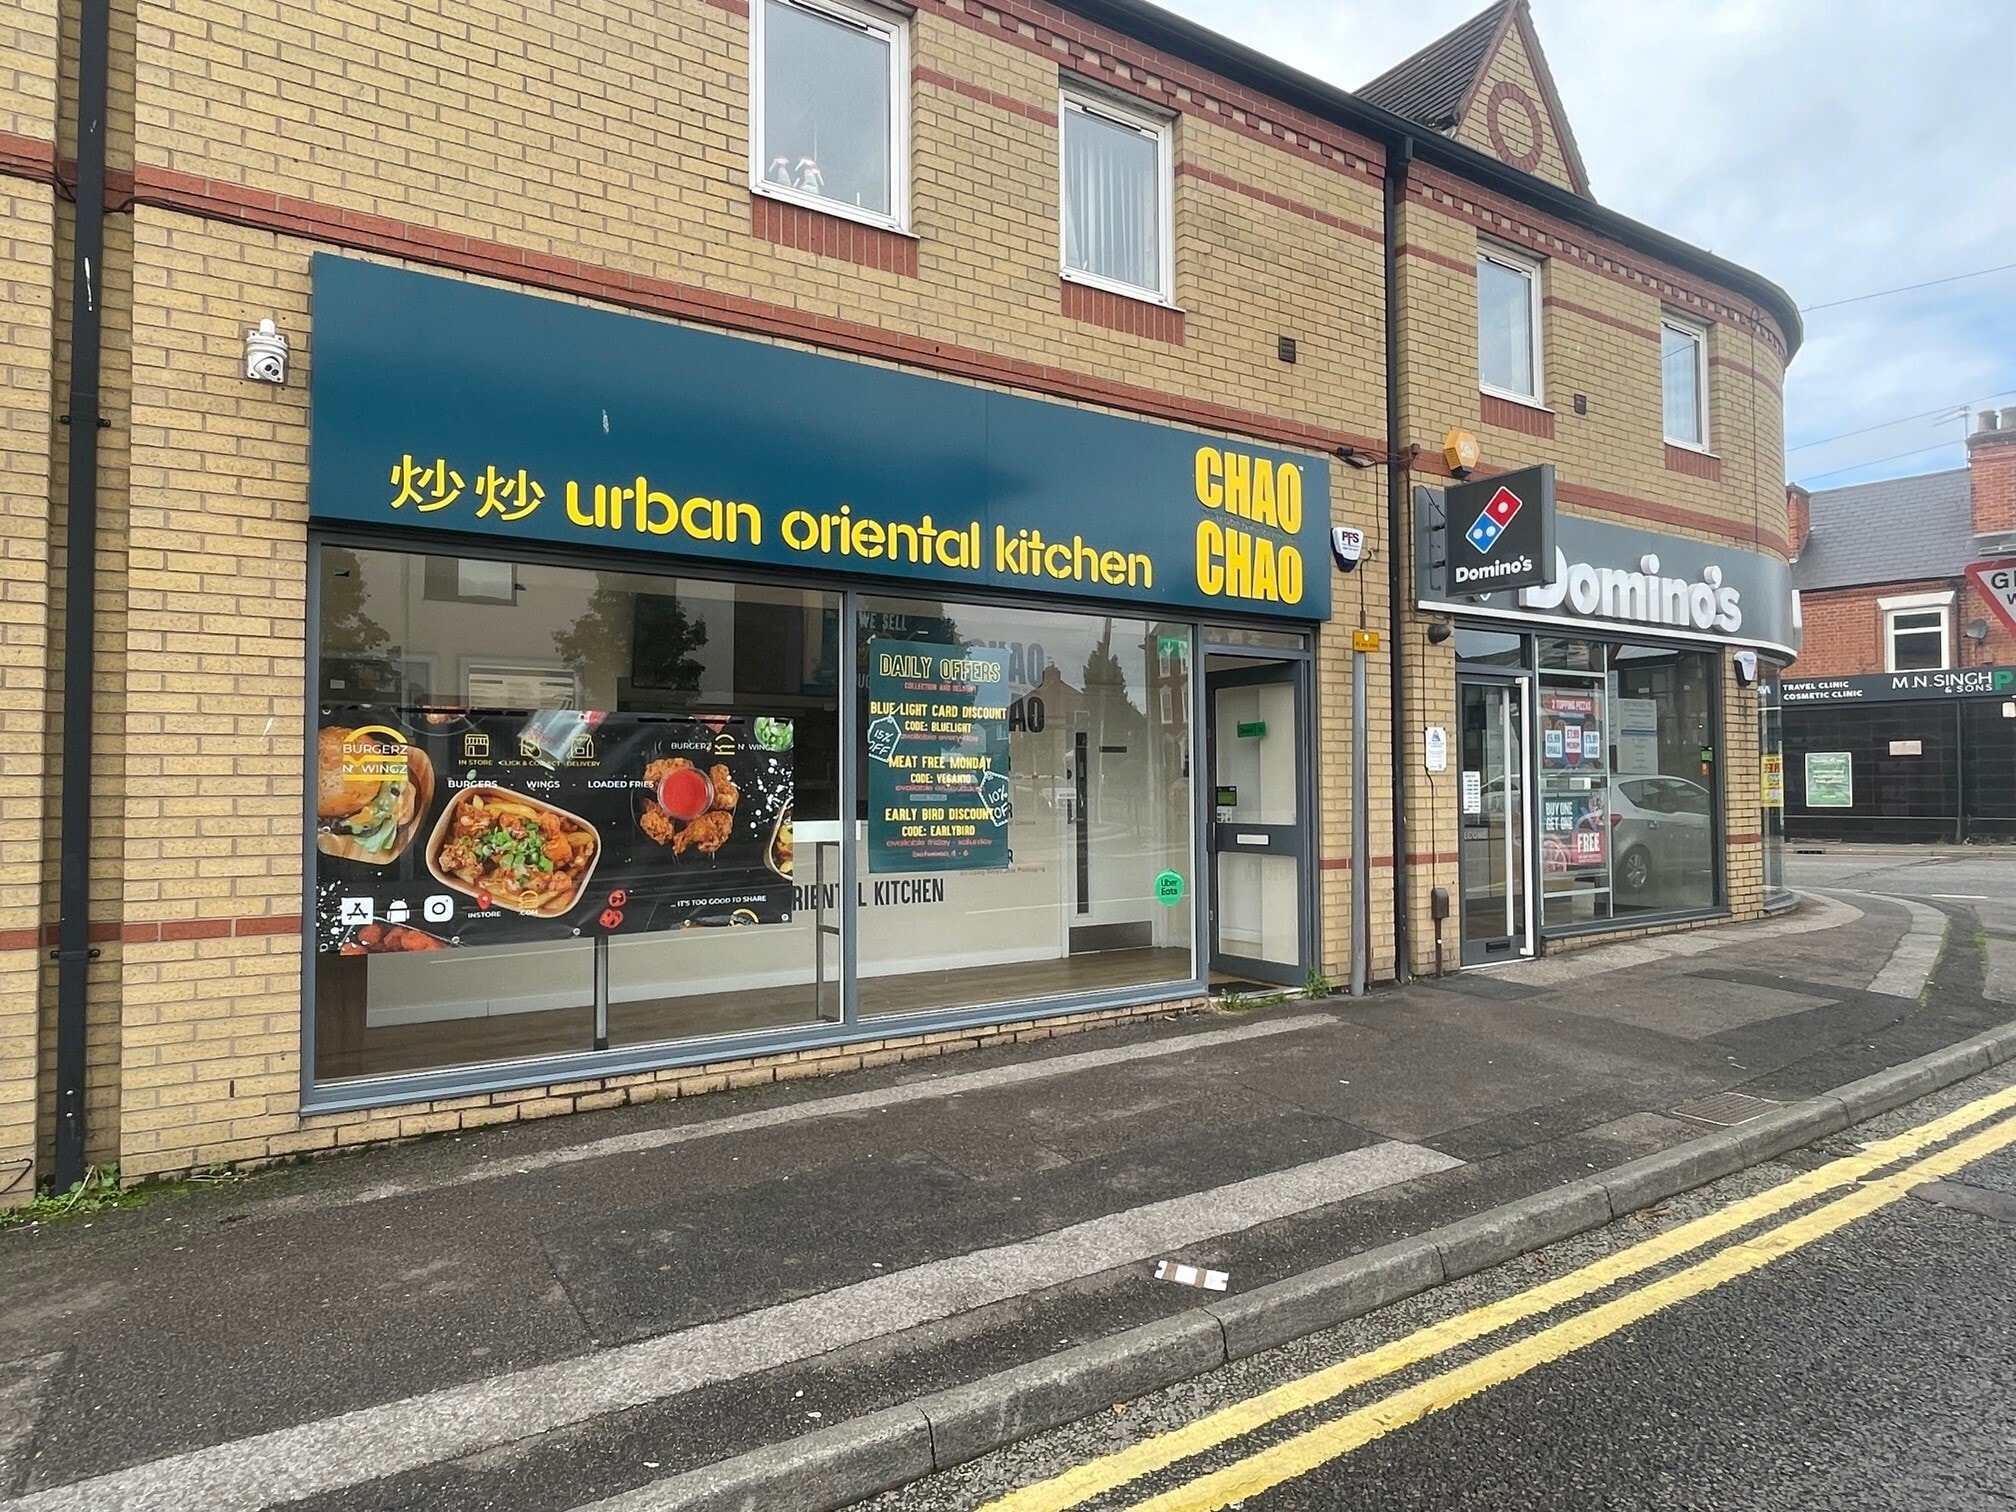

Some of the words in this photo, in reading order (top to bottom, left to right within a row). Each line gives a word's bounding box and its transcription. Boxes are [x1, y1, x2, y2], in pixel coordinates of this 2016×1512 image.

[390, 454, 546, 521] 炒炒
[1195, 446, 1302, 535] CHAO
[566, 476, 761, 545] urban
[781, 505, 980, 571] oriental
[995, 524, 1153, 589] kitchen
[1341, 531, 1360, 545] PFS
[1195, 519, 1303, 605] CHAO
[1455, 554, 1533, 583] Domino's
[858, 611, 876, 629] WE
[881, 614, 907, 632] SELL
[880, 653, 932, 679] DAILY
[940, 658, 1001, 682] OFFERS
[1782, 683, 1816, 691] TRAVEL
[1818, 681, 1849, 689] CLINIC
[1957, 683, 1993, 693] SONS
[1783, 692, 1829, 700] COSMETIC
[1832, 690, 1863, 698] CLINIC
[870, 701, 895, 715] BLUE
[900, 704, 928, 717] LIGHT
[931, 705, 958, 718] CARD
[962, 707, 1007, 720] DISCOUNT
[905, 721, 928, 731] CODE:
[931, 722, 972, 733] BLUELIGHT
[873, 729, 894, 743] 15%
[342, 743, 408, 755] BURGERZ
[671, 741, 712, 750] BURGERZ
[889, 755, 917, 769] MEAT
[922, 755, 946, 769] FREE
[949, 756, 992, 770] MONDAY
[361, 764, 408, 774] WINGZ
[448, 779, 498, 788] BURGERS
[526, 780, 561, 788] WINGS
[587, 780, 628, 789] LOADED
[629, 780, 654, 788] FRIES
[910, 773, 933, 784] CODE:
[987, 785, 1008, 803] 10%
[885, 808, 918, 820] EARLY
[922, 808, 945, 820] BIRD
[948, 808, 994, 820] DISCOUNT
[1545, 802, 1559, 816] BUY
[1560, 801, 1573, 815] ONE
[1546, 816, 1559, 831] GET
[902, 826, 927, 837] CODE:
[930, 825, 976, 836] EARLYBIRD
[1577, 832, 1600, 853] FREE
[1160, 878, 1178, 887] Uber
[874, 878, 944, 906] KITCHEN
[1160, 888, 1178, 896] Eats
[691, 898, 708, 906] TOO
[708, 897, 731, 905] GOOD
[742, 894, 767, 902] SHARE
[467, 910, 501, 919] INSTORE
